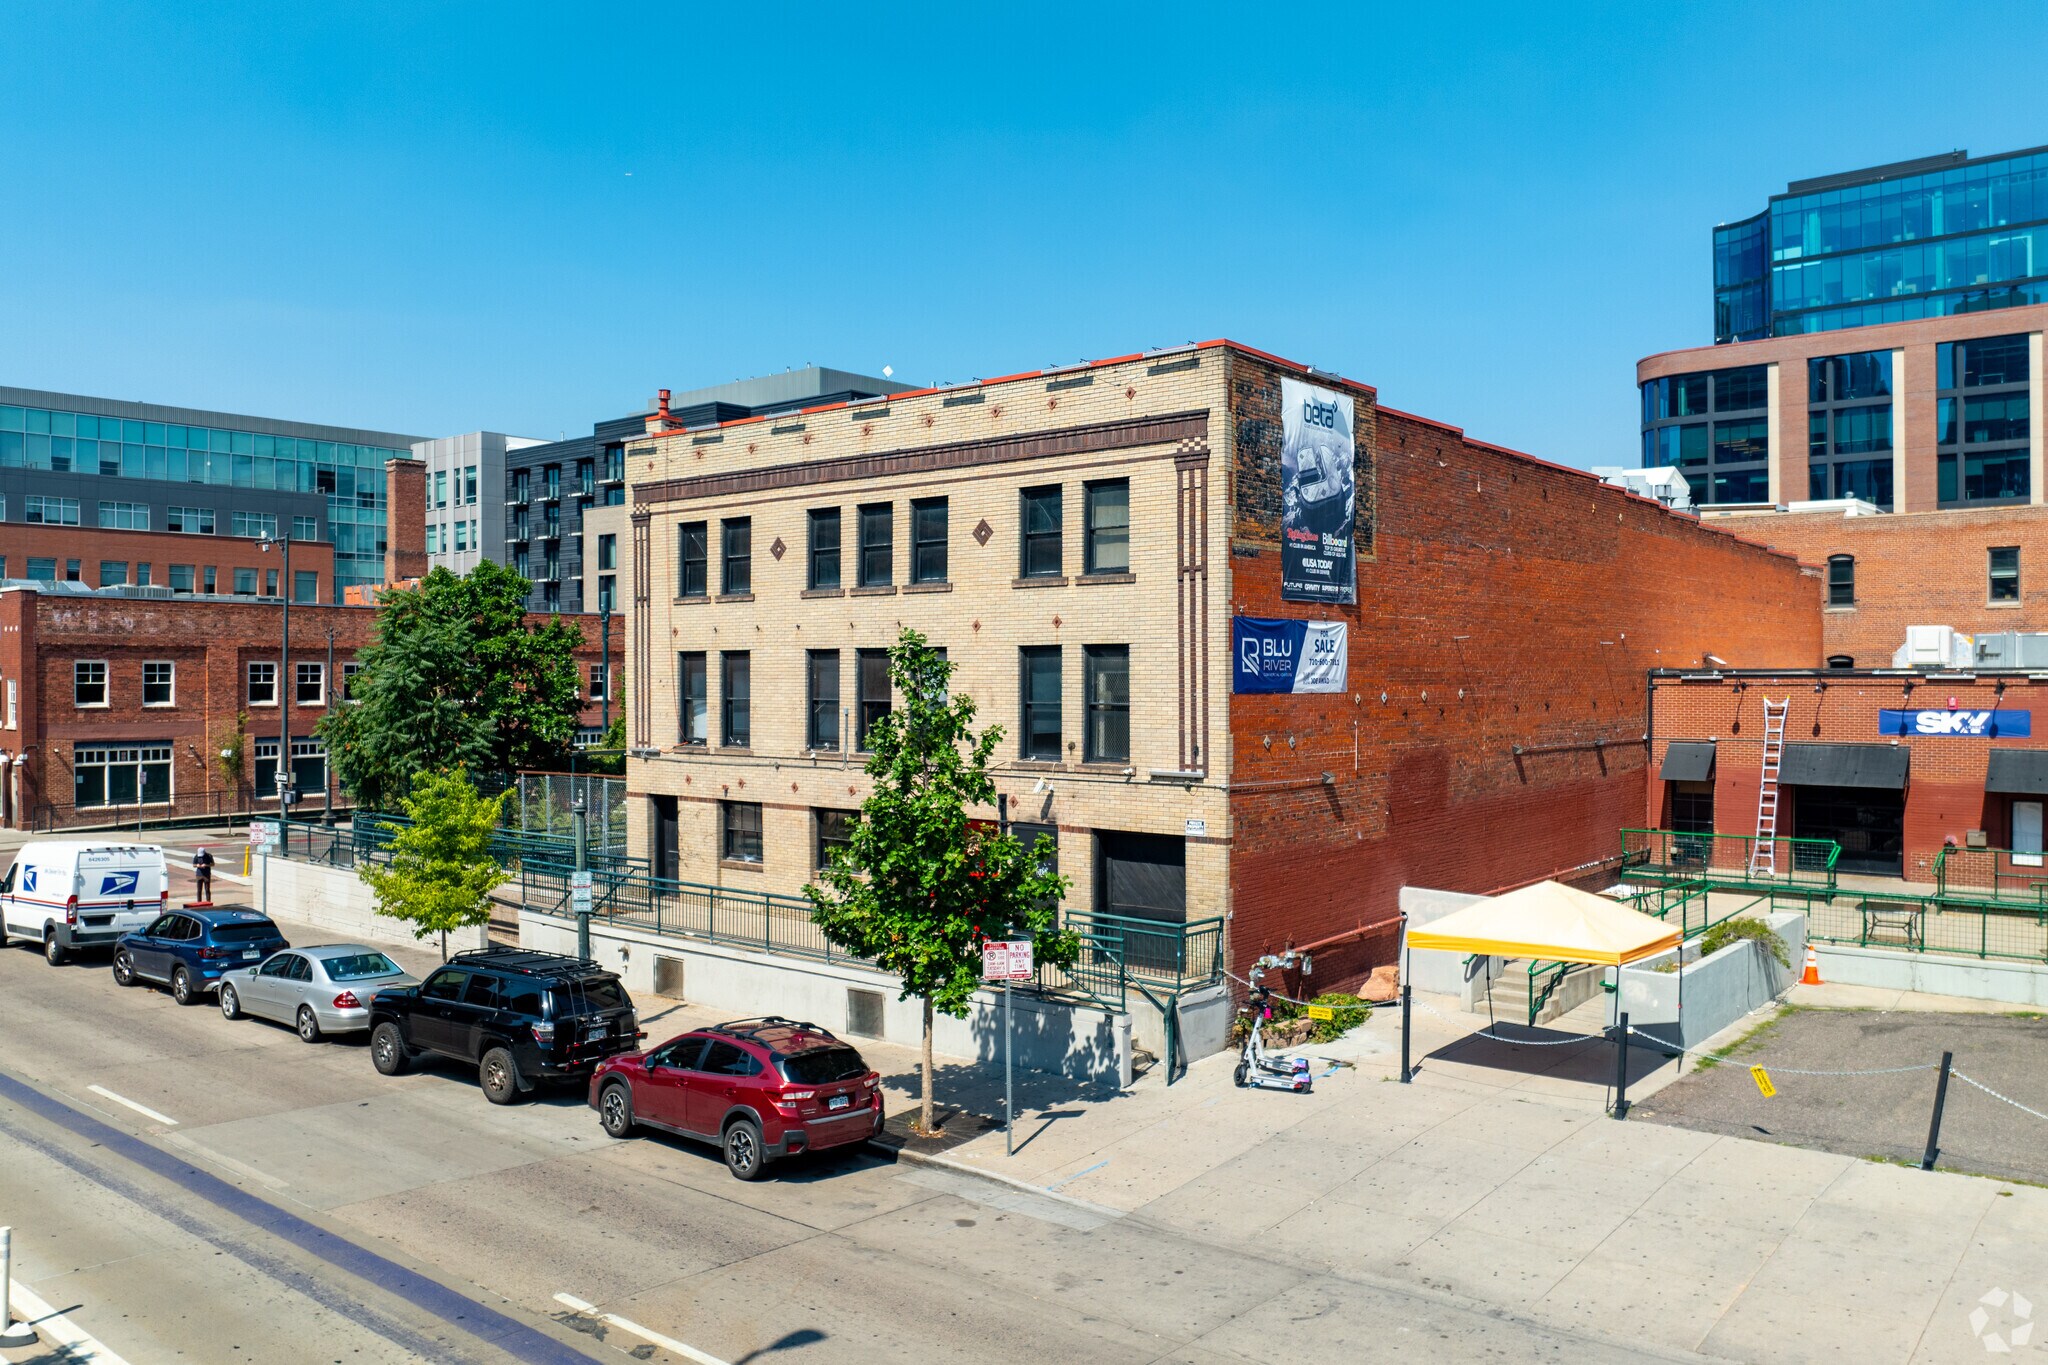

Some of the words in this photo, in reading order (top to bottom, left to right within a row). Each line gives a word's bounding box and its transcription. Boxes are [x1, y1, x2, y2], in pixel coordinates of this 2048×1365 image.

[1304, 399, 1334, 429] beta
[1306, 558, 1317, 568] USA
[1317, 559, 1334, 570] TODAY
[1263, 638, 1292, 657] BLU
[1314, 638, 1335, 653] SALE
[1263, 659, 1292, 671] RIVER
[1915, 711, 1991, 734] SKY
